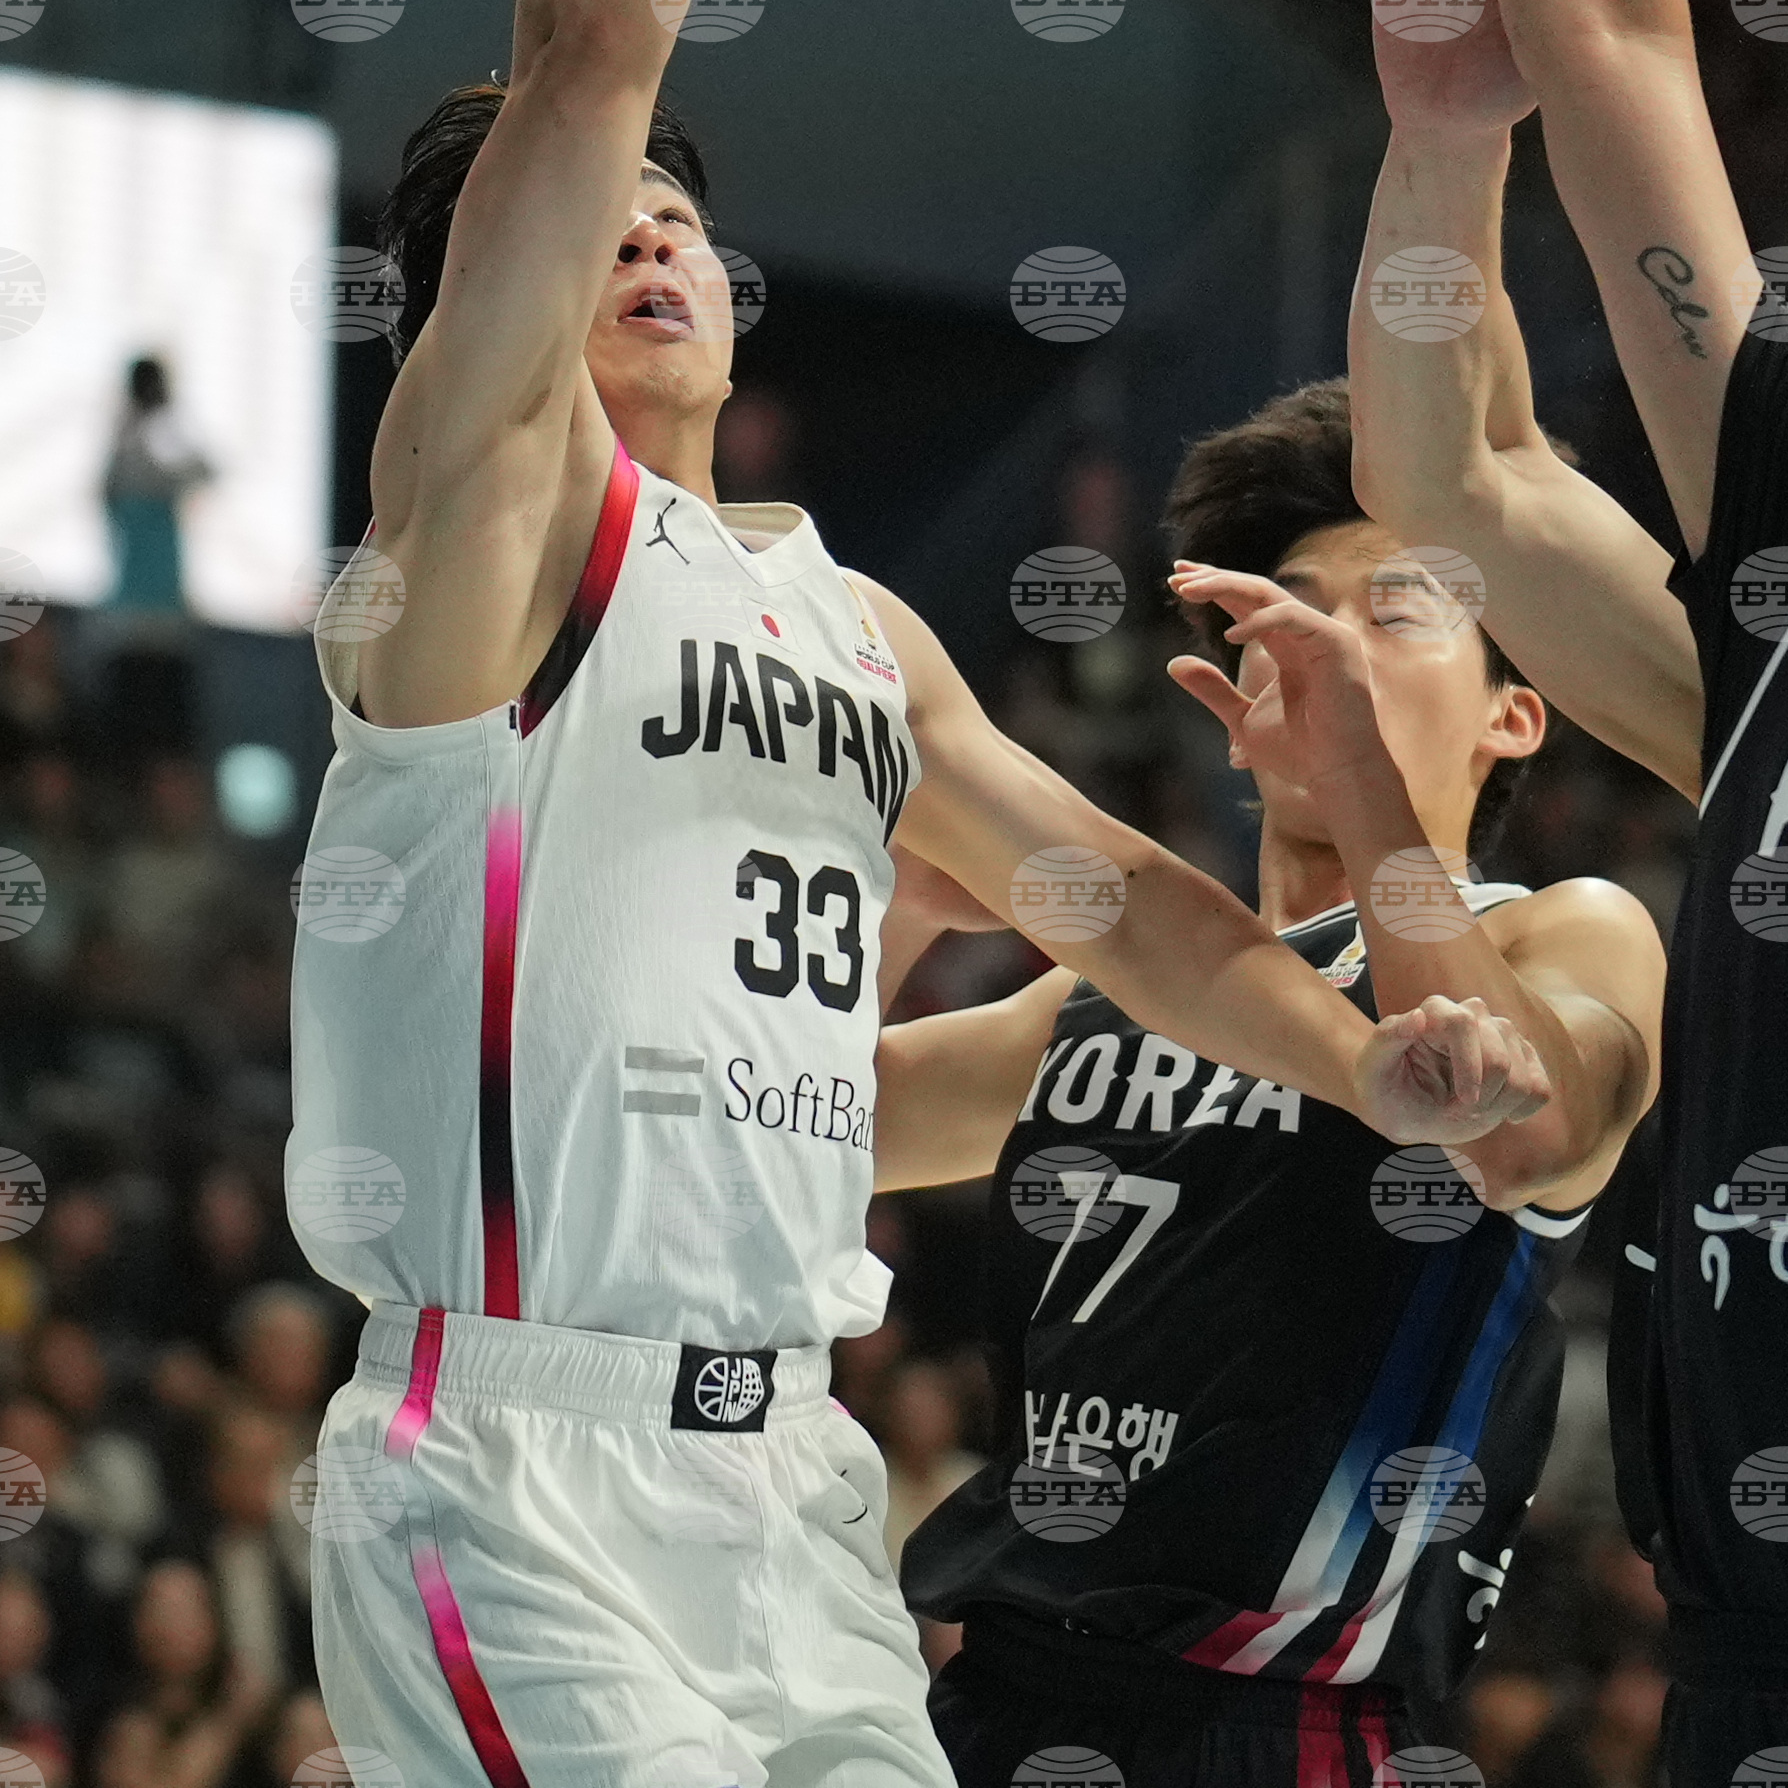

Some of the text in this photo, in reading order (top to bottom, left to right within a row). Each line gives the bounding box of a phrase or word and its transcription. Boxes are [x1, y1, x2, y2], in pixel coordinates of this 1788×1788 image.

[642, 639, 909, 848] JAPAN
[734, 849, 864, 1013] 33
[1031, 1170, 1181, 1323] 77
